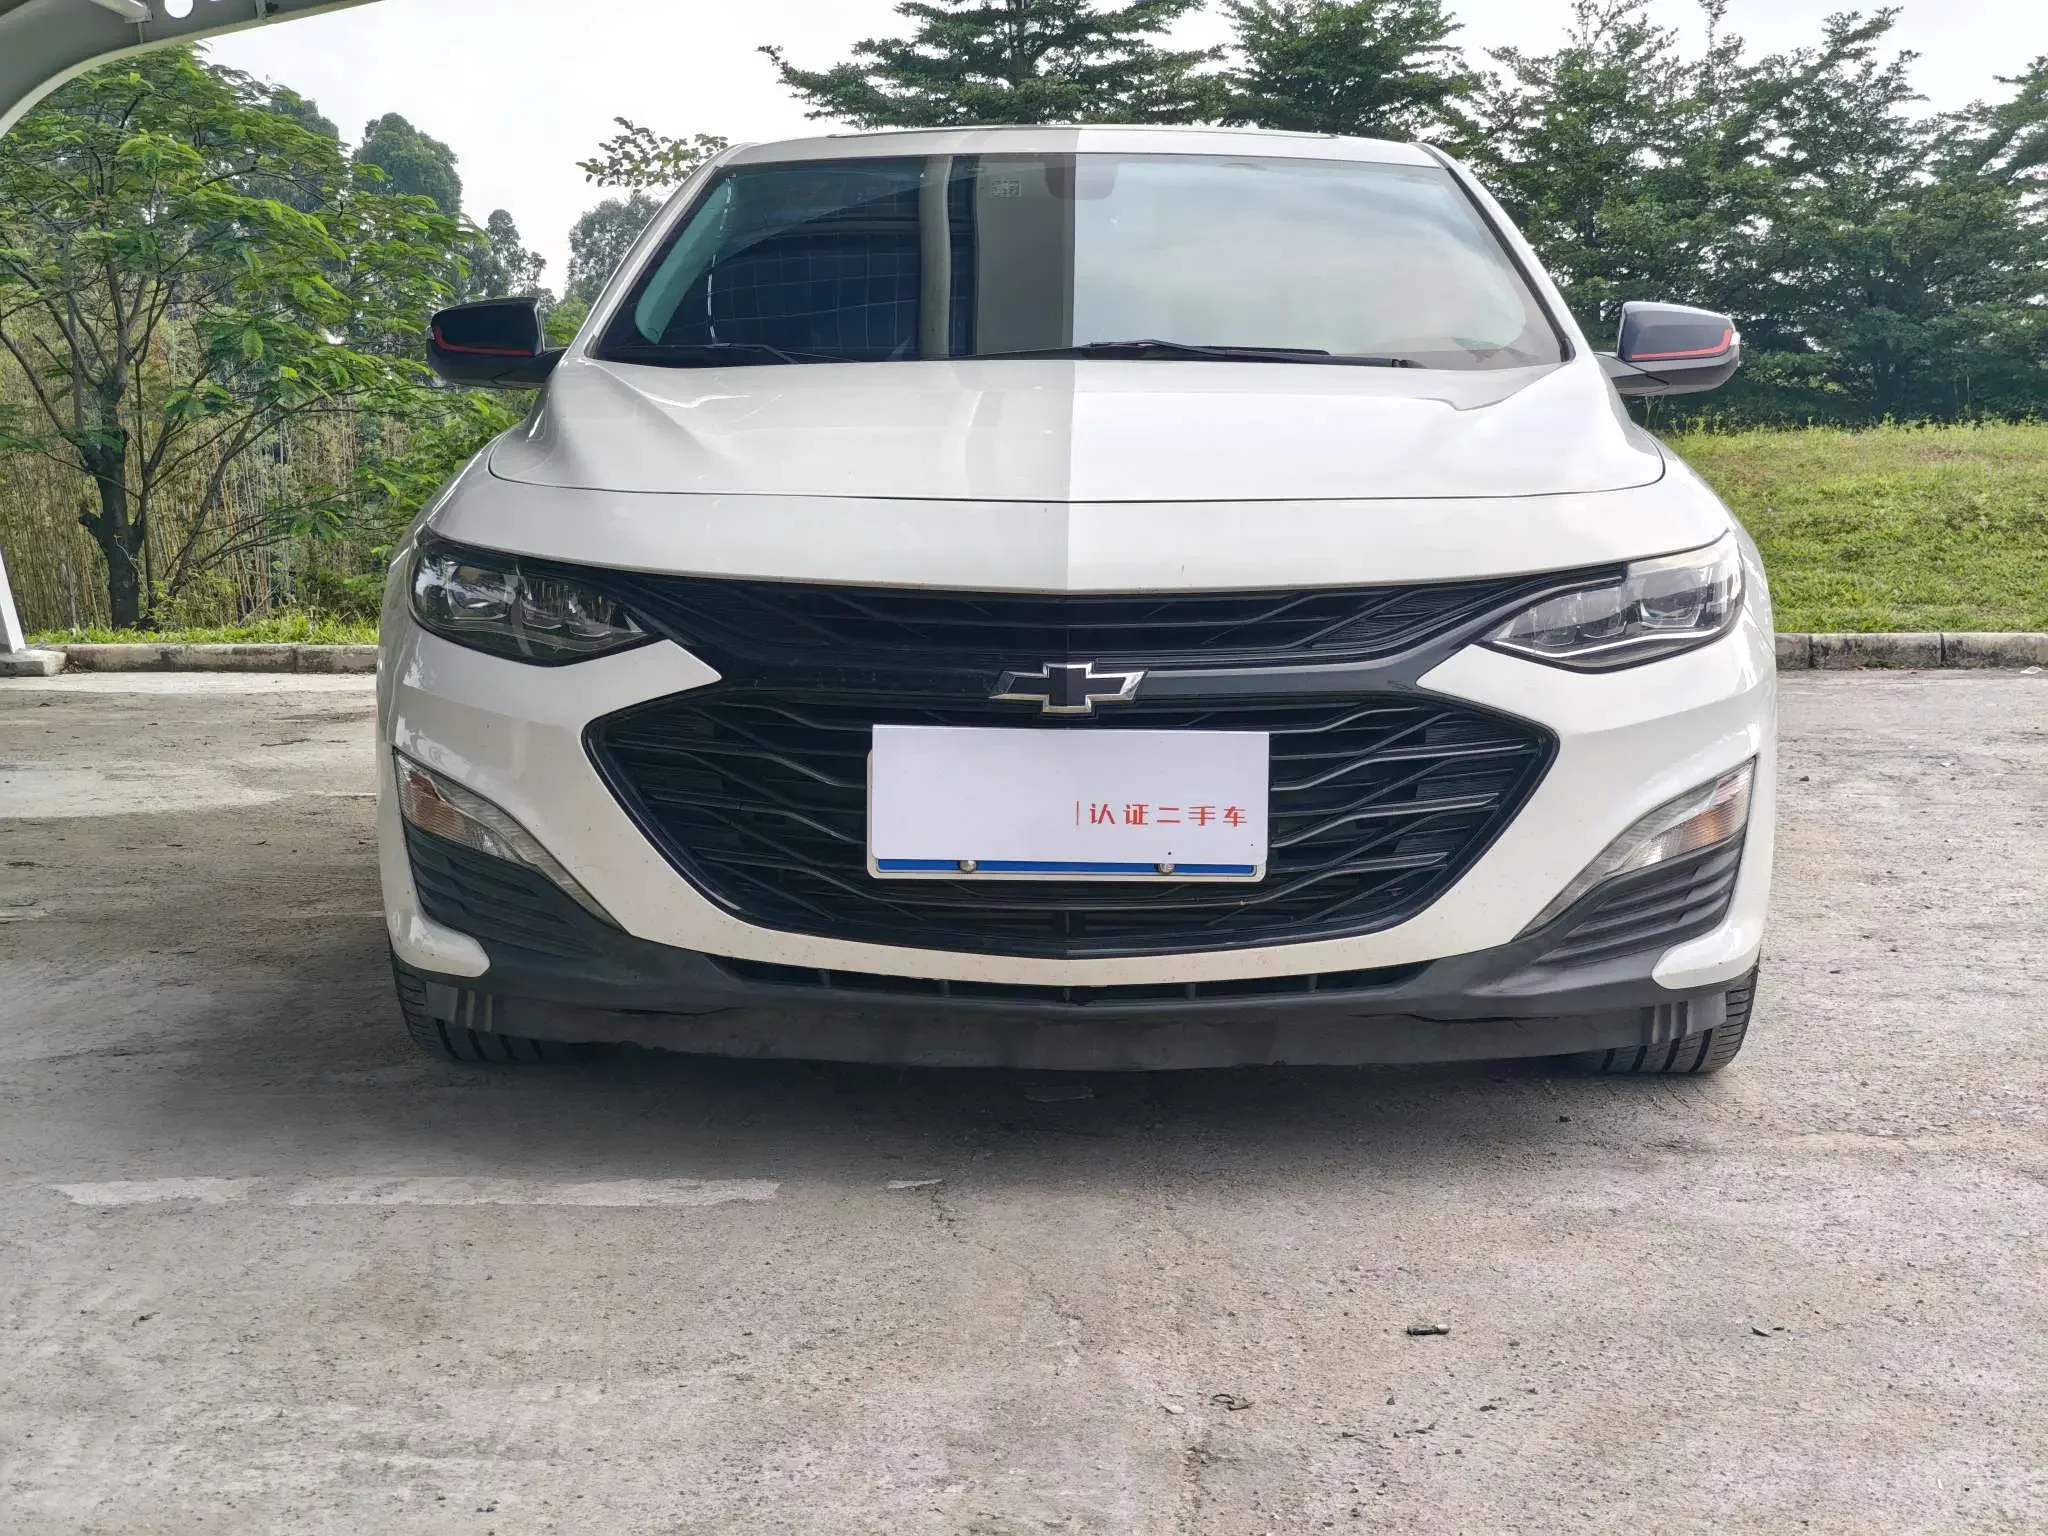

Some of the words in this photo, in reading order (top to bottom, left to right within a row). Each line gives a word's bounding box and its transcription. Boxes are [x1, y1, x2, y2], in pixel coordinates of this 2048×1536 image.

[1089, 803, 1247, 827] 认证二手车
